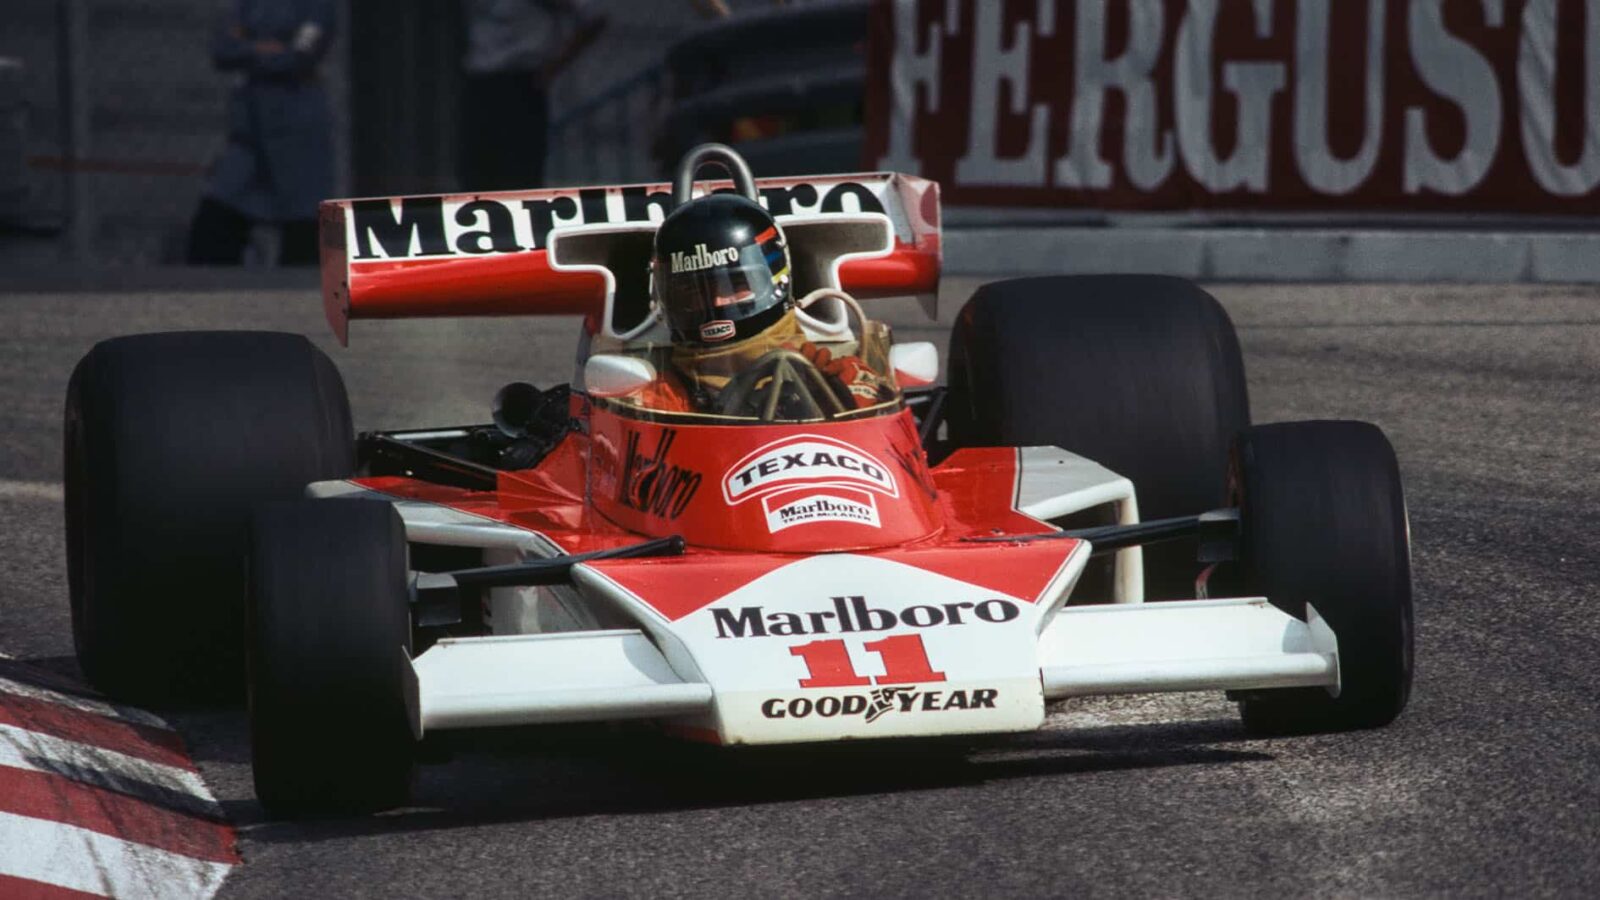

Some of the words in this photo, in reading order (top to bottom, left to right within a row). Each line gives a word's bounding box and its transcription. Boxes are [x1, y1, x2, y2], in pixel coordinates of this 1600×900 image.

[350, 182, 887, 259] Marlro
[670, 244, 739, 274] Marlboro
[620, 428, 703, 520] Marlboro
[735, 451, 884, 487] TEXACO
[780, 500, 870, 520] Marlboro
[783, 513, 814, 523] TEAM
[708, 595, 1020, 639] Marlboro
[788, 633, 948, 689] 11
